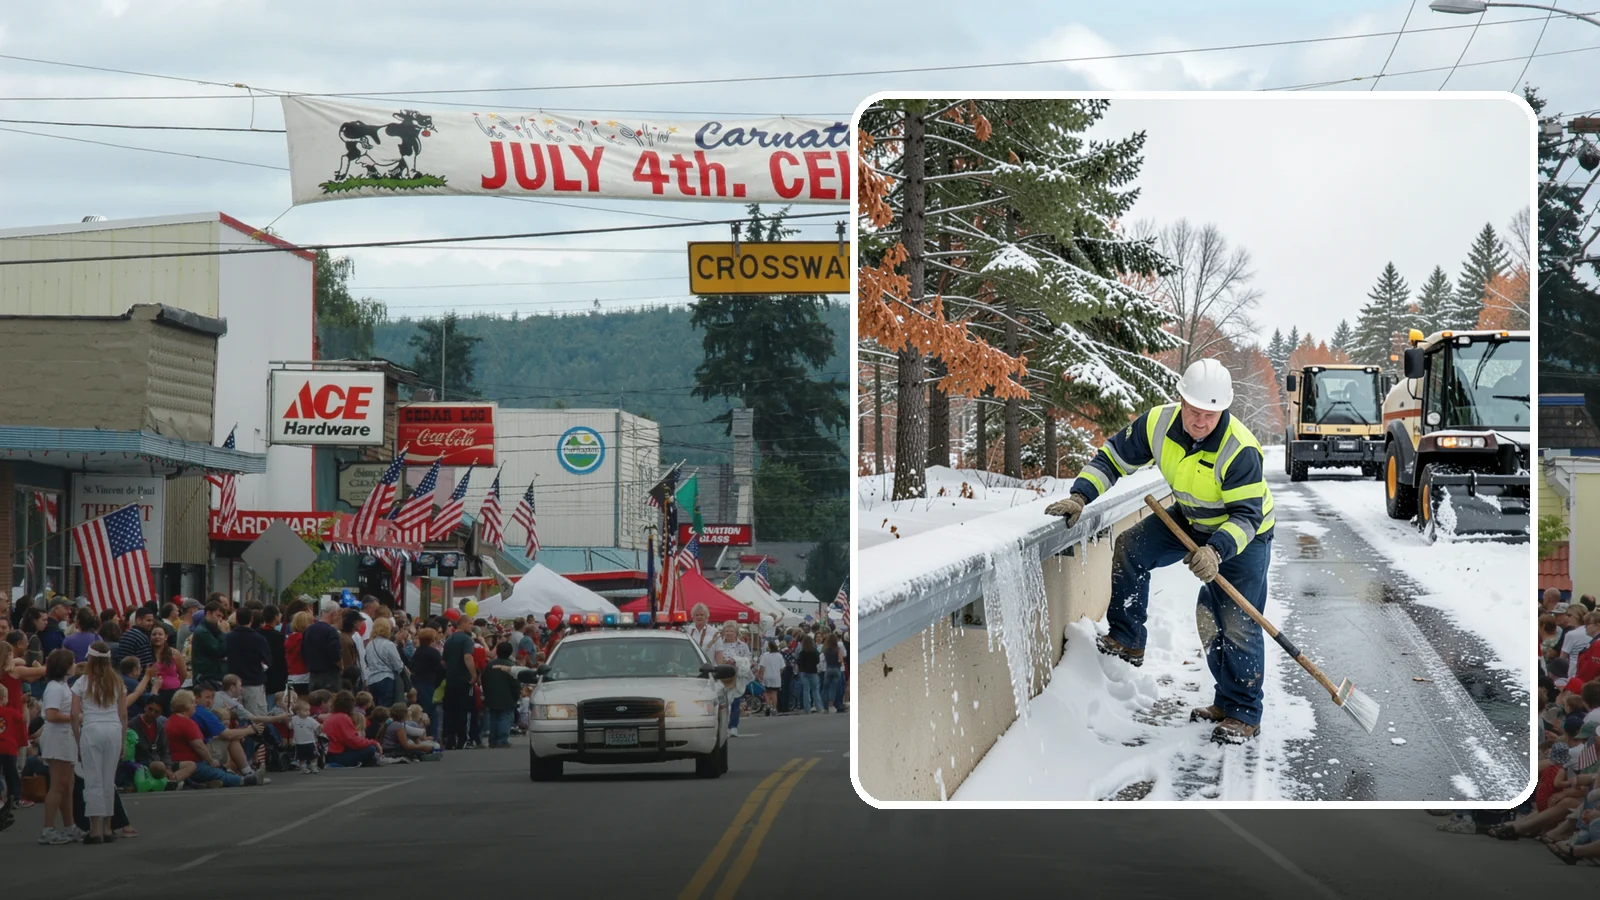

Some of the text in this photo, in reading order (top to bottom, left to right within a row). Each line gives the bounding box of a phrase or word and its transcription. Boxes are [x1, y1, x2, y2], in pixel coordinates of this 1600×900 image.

[695, 121, 850, 150] Carnat
[481, 141, 605, 192] JULY
[632, 150, 746, 197] 4th.
[697, 254, 850, 280] CROSSWA
[282, 380, 373, 420] ACE
[405, 409, 485, 422] CEDAR LOG
[283, 421, 371, 436] Hardware
[416, 428, 477, 446] Coca-Cola
[353, 467, 384, 480] Simpl
[83, 485, 155, 495] St. Vincent de Paul
[81, 503, 154, 522] THT
[688, 526, 741, 535] CRNATION
[699, 535, 731, 543] GLASS
